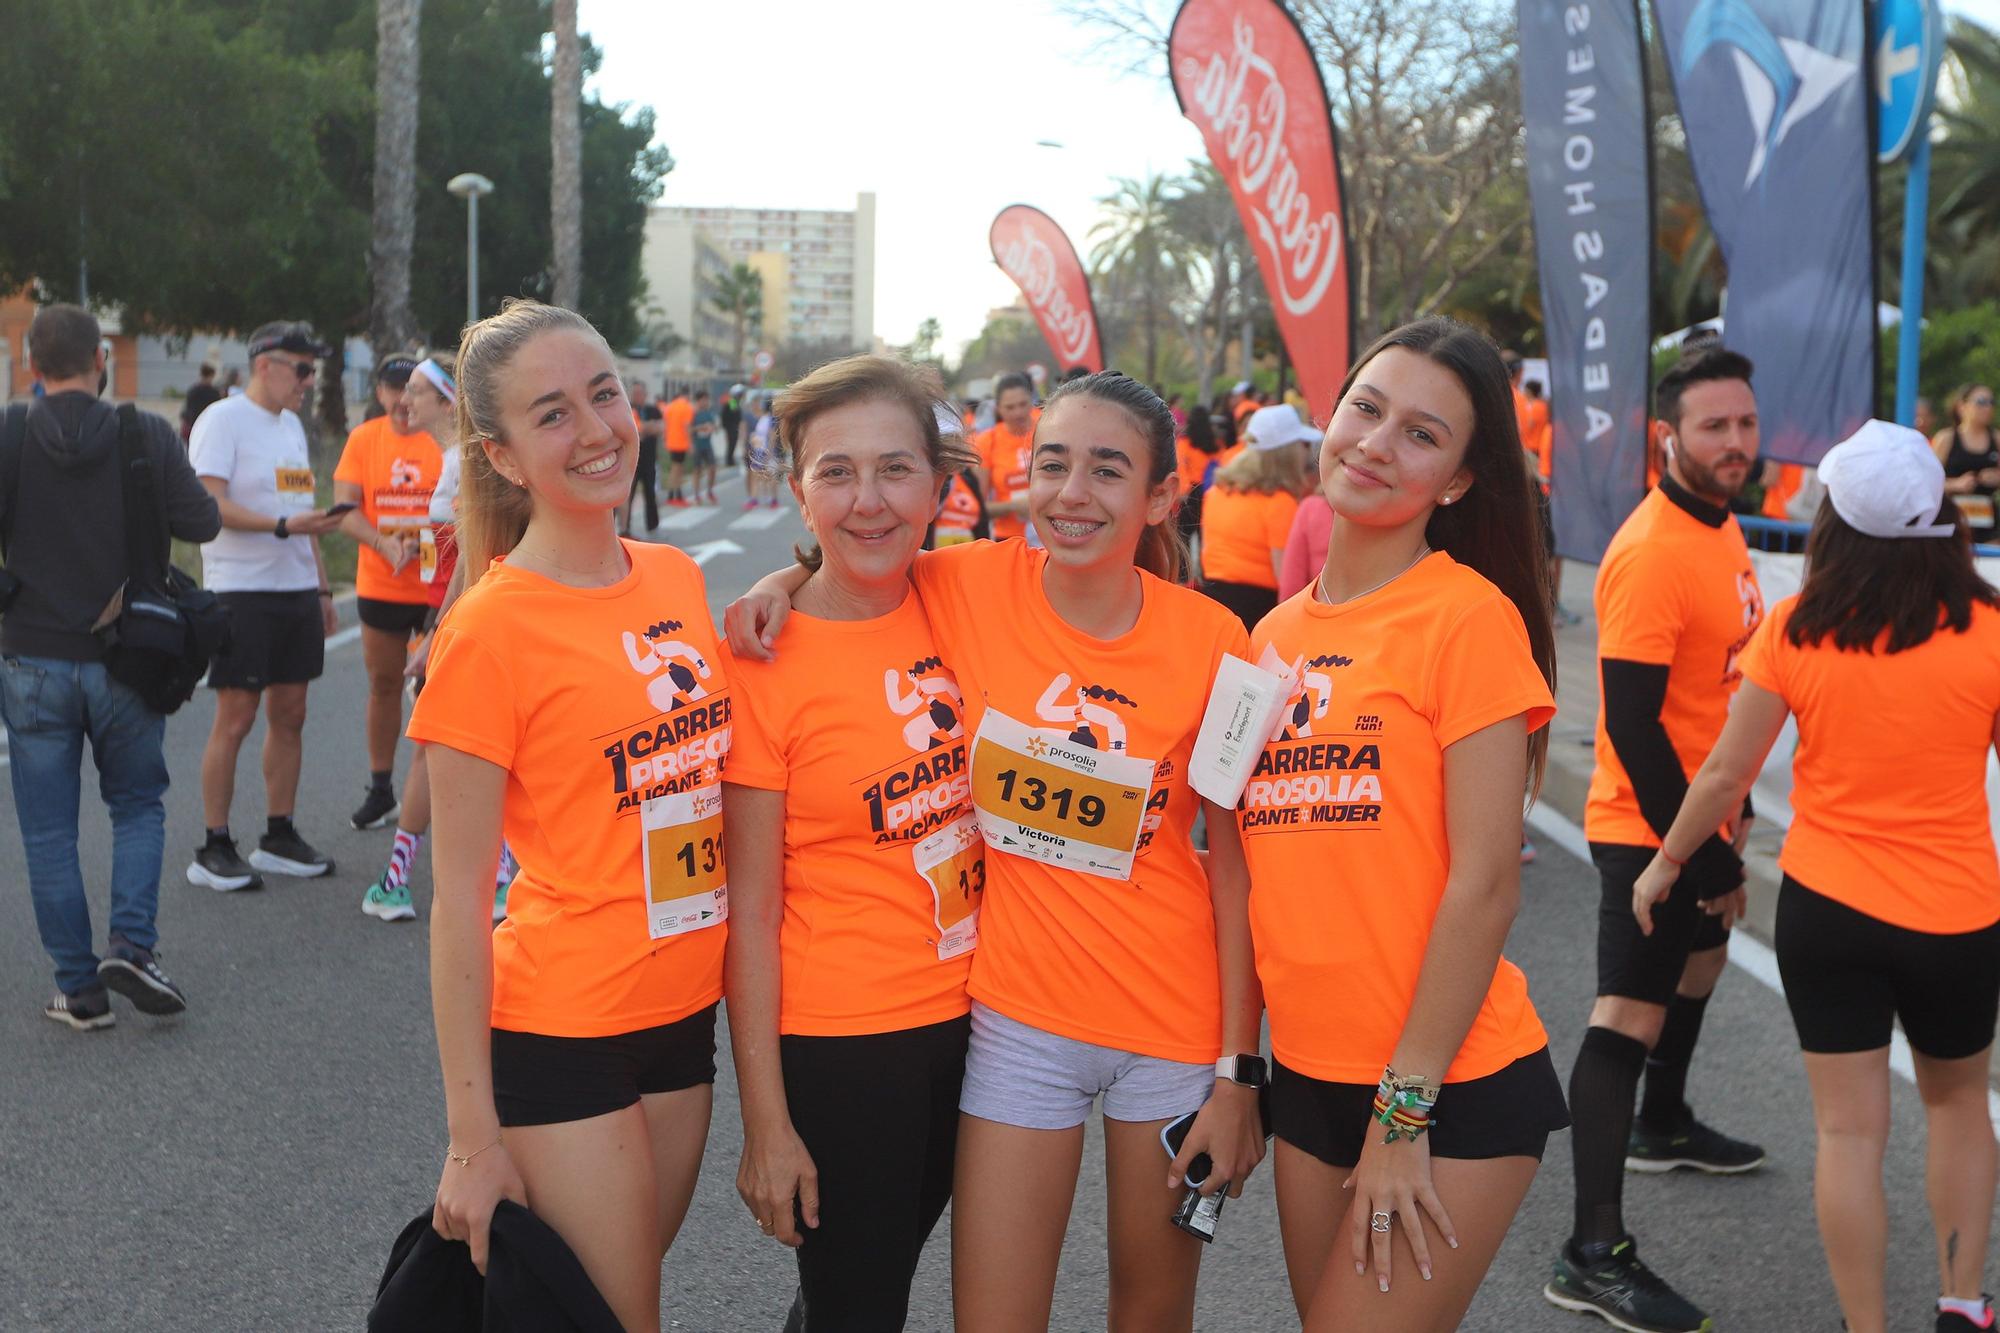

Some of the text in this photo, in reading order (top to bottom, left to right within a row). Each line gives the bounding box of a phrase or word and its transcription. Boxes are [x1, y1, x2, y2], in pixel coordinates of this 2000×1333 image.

[1354, 720, 1383, 731] run!
[1357, 715, 1379, 723] run
[1049, 745, 1097, 769] prosolia
[1252, 744, 1381, 777] ARRERA
[997, 769, 1106, 828] 1319
[1310, 804, 1382, 823] MUJER
[1018, 825, 1066, 847] Victoria
